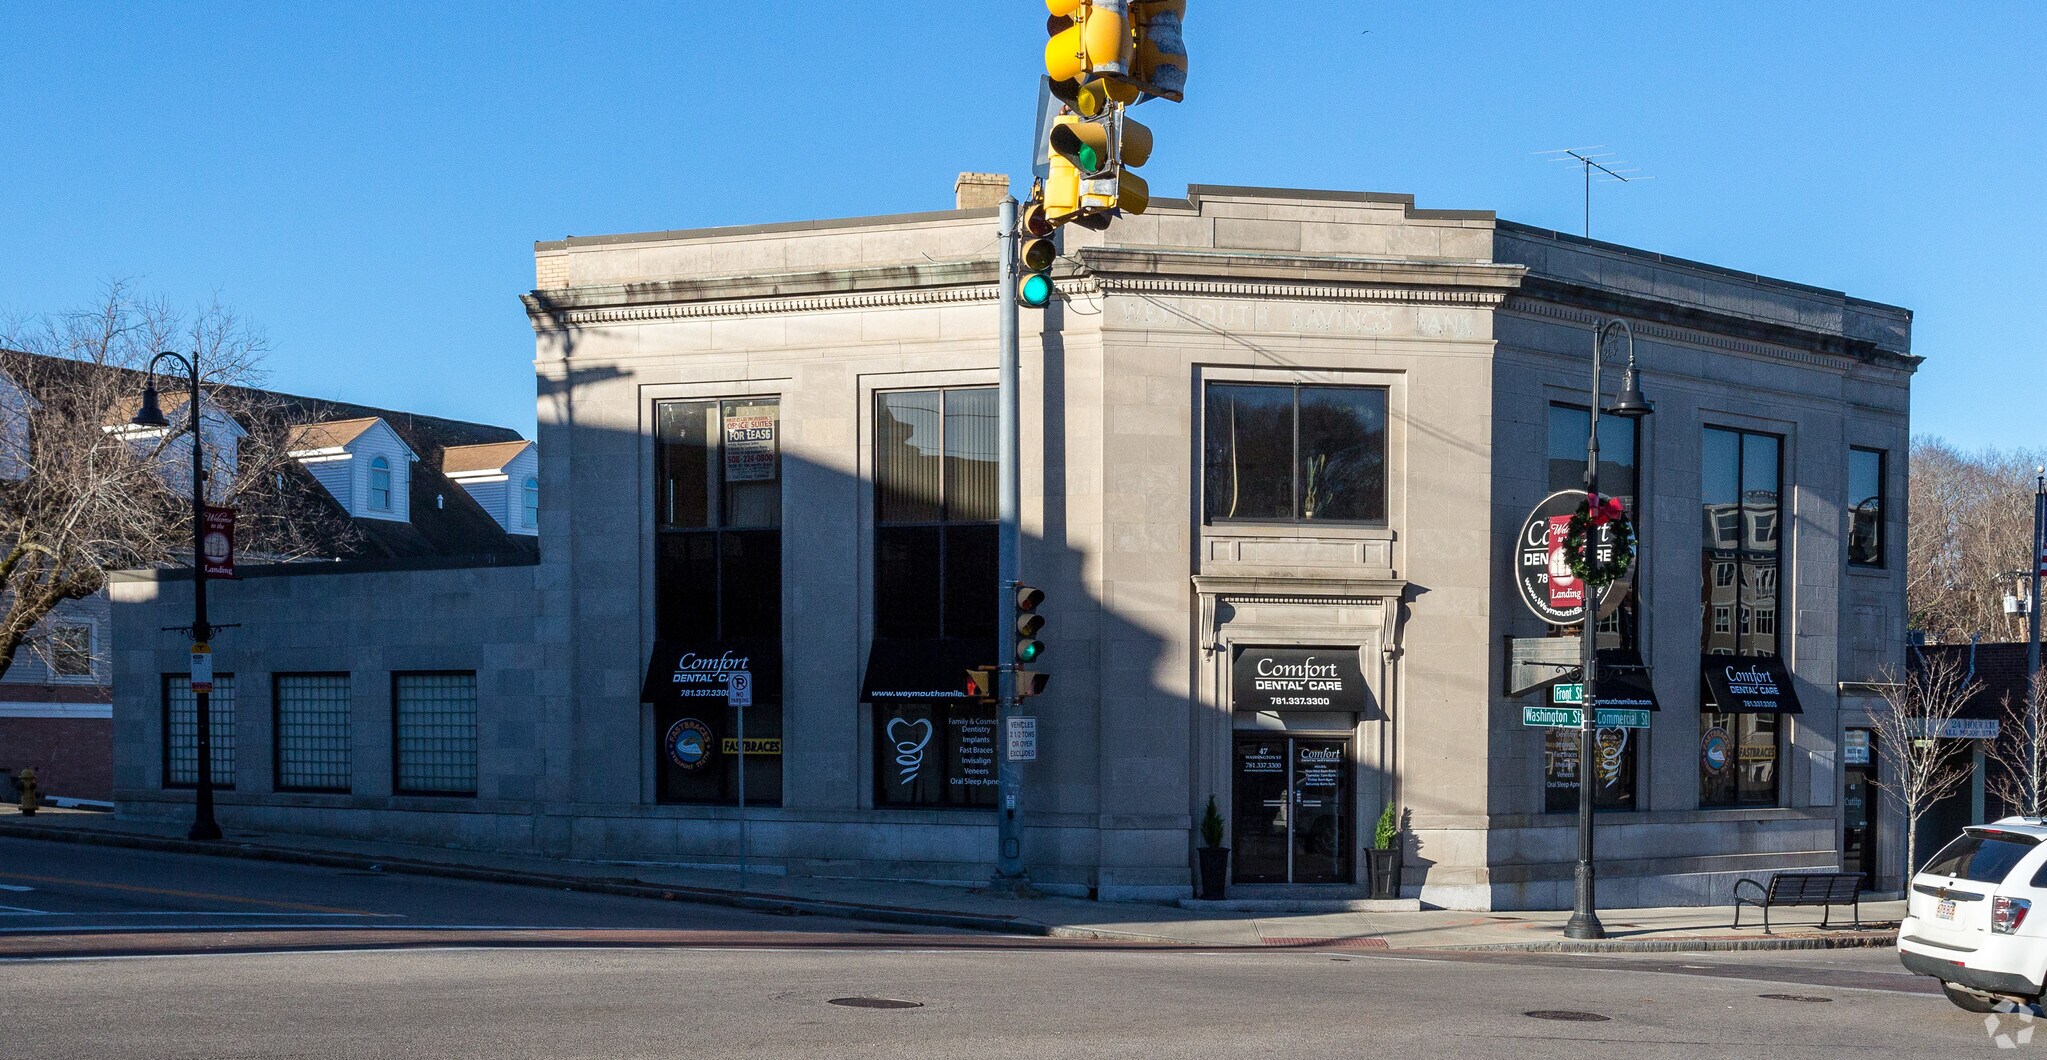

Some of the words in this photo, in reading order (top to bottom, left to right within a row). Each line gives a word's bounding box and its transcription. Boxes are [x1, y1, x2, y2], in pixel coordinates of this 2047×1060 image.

[1120, 301, 1269, 327] WEYMOUTH
[1291, 307, 1393, 332] SAVINGS
[1416, 311, 1473, 337] BANK
[729, 430, 745, 441] FOR
[204, 511, 232, 523] Welcome
[204, 565, 233, 576] Landing
[1551, 587, 1582, 600] Landing
[679, 650, 750, 677] Comfort
[1257, 656, 1338, 684] Comfort
[673, 673, 713, 683] DENTAL
[1725, 664, 1774, 690] Comfort
[1255, 681, 1304, 691] DENTAL
[1308, 681, 1343, 691] CARE
[1729, 686, 1758, 694] DENTAL
[1760, 687, 1780, 695] CARE
[1555, 687, 1572, 700] Front
[1575, 686, 1583, 700] St
[1270, 697, 1330, 706] 781.337.3300
[1595, 698, 1653, 706] ymouthsmiles.com
[1525, 708, 1568, 725] Washington
[1572, 710, 1581, 724] St
[1597, 711, 1637, 726] Commercial
[1640, 713, 1648, 726] St
[948, 718, 969, 727] Family
[1010, 721, 1034, 729] VEHICLES
[961, 726, 991, 734] Dentistry
[962, 736, 990, 744] Implants
[1011, 740, 1020, 748] OR
[1020, 740, 1033, 748] OVER
[724, 741, 780, 752] FASBRACES
[959, 746, 972, 754] Fast
[973, 746, 993, 754] Braces
[1301, 747, 1340, 759] Comfort
[1740, 747, 1775, 758] FASTBRACES
[961, 757, 992, 766] Invisalign
[963, 767, 989, 775] Veneers
[950, 777, 964, 785] Oral
[964, 777, 982, 786] Sleep
[982, 778, 1000, 786] Apne
[1557, 781, 1569, 789] Sleep
